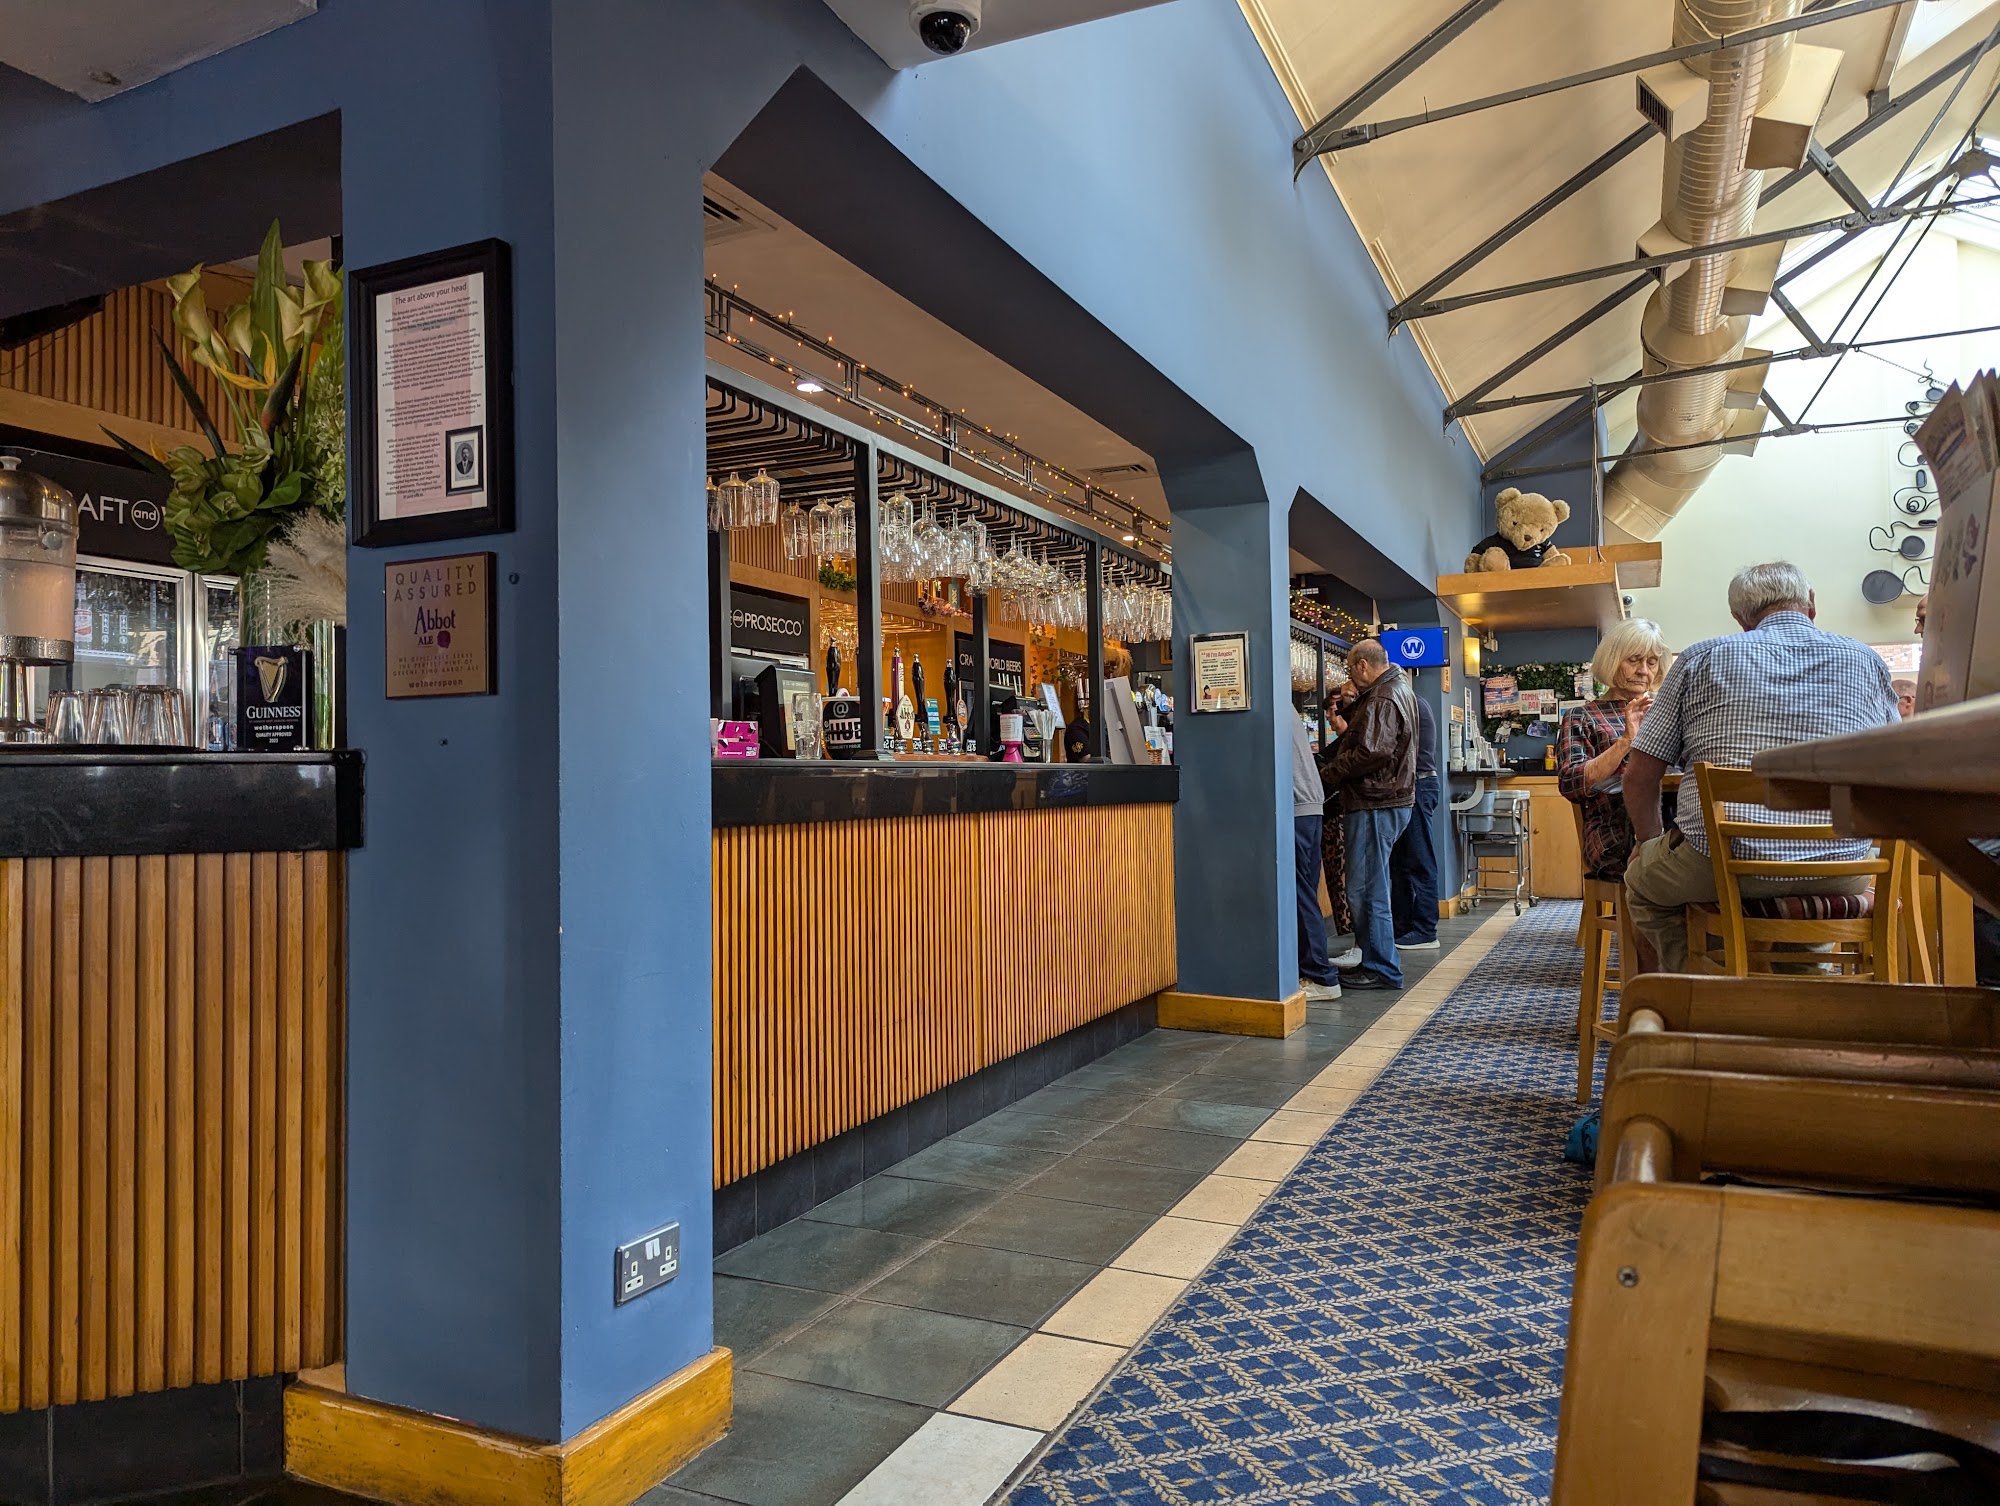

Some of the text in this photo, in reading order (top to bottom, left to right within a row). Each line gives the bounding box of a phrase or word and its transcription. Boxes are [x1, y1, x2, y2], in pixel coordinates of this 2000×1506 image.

[394, 282, 467, 305] The art above your head
[66, 490, 157, 525] AFT and
[396, 564, 475, 586] QUALITY
[394, 581, 476, 602] ASSURED
[414, 605, 456, 635] Abbot
[744, 612, 802, 636] PROSECCO
[418, 636, 434, 646] ALE
[959, 653, 1022, 672] CRA ORLD BEERS
[409, 679, 463, 688] wetherspoon
[246, 706, 301, 719] GUINNESS
